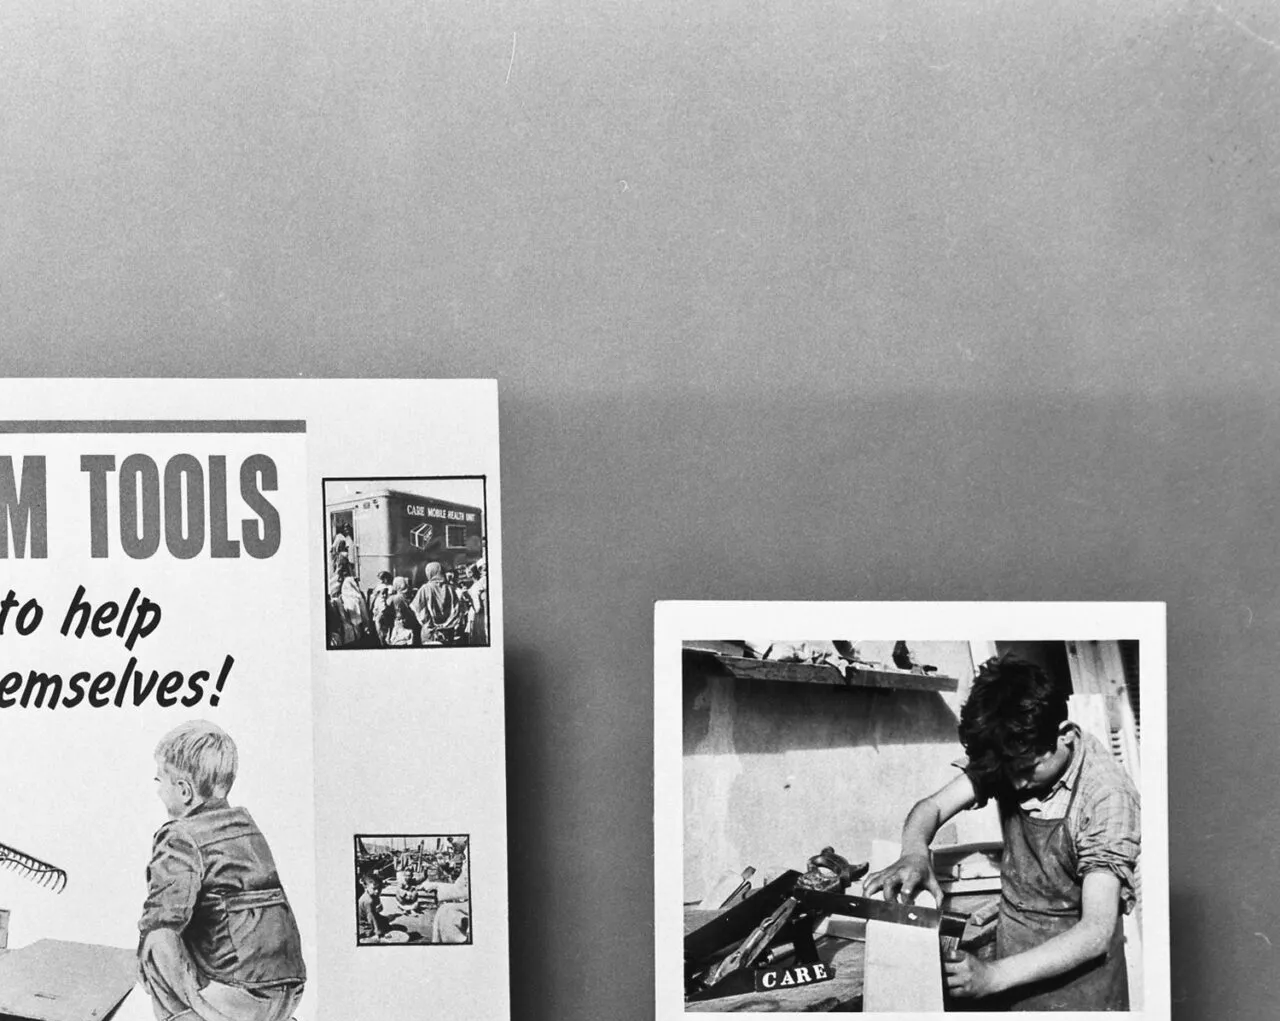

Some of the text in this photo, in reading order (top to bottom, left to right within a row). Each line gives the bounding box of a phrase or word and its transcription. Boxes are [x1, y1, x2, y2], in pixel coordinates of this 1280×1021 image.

[80, 454, 281, 559] TOOLS
[407, 505, 424, 516] CARE
[60, 585, 161, 651] help
[762, 964, 827, 987] CARE
